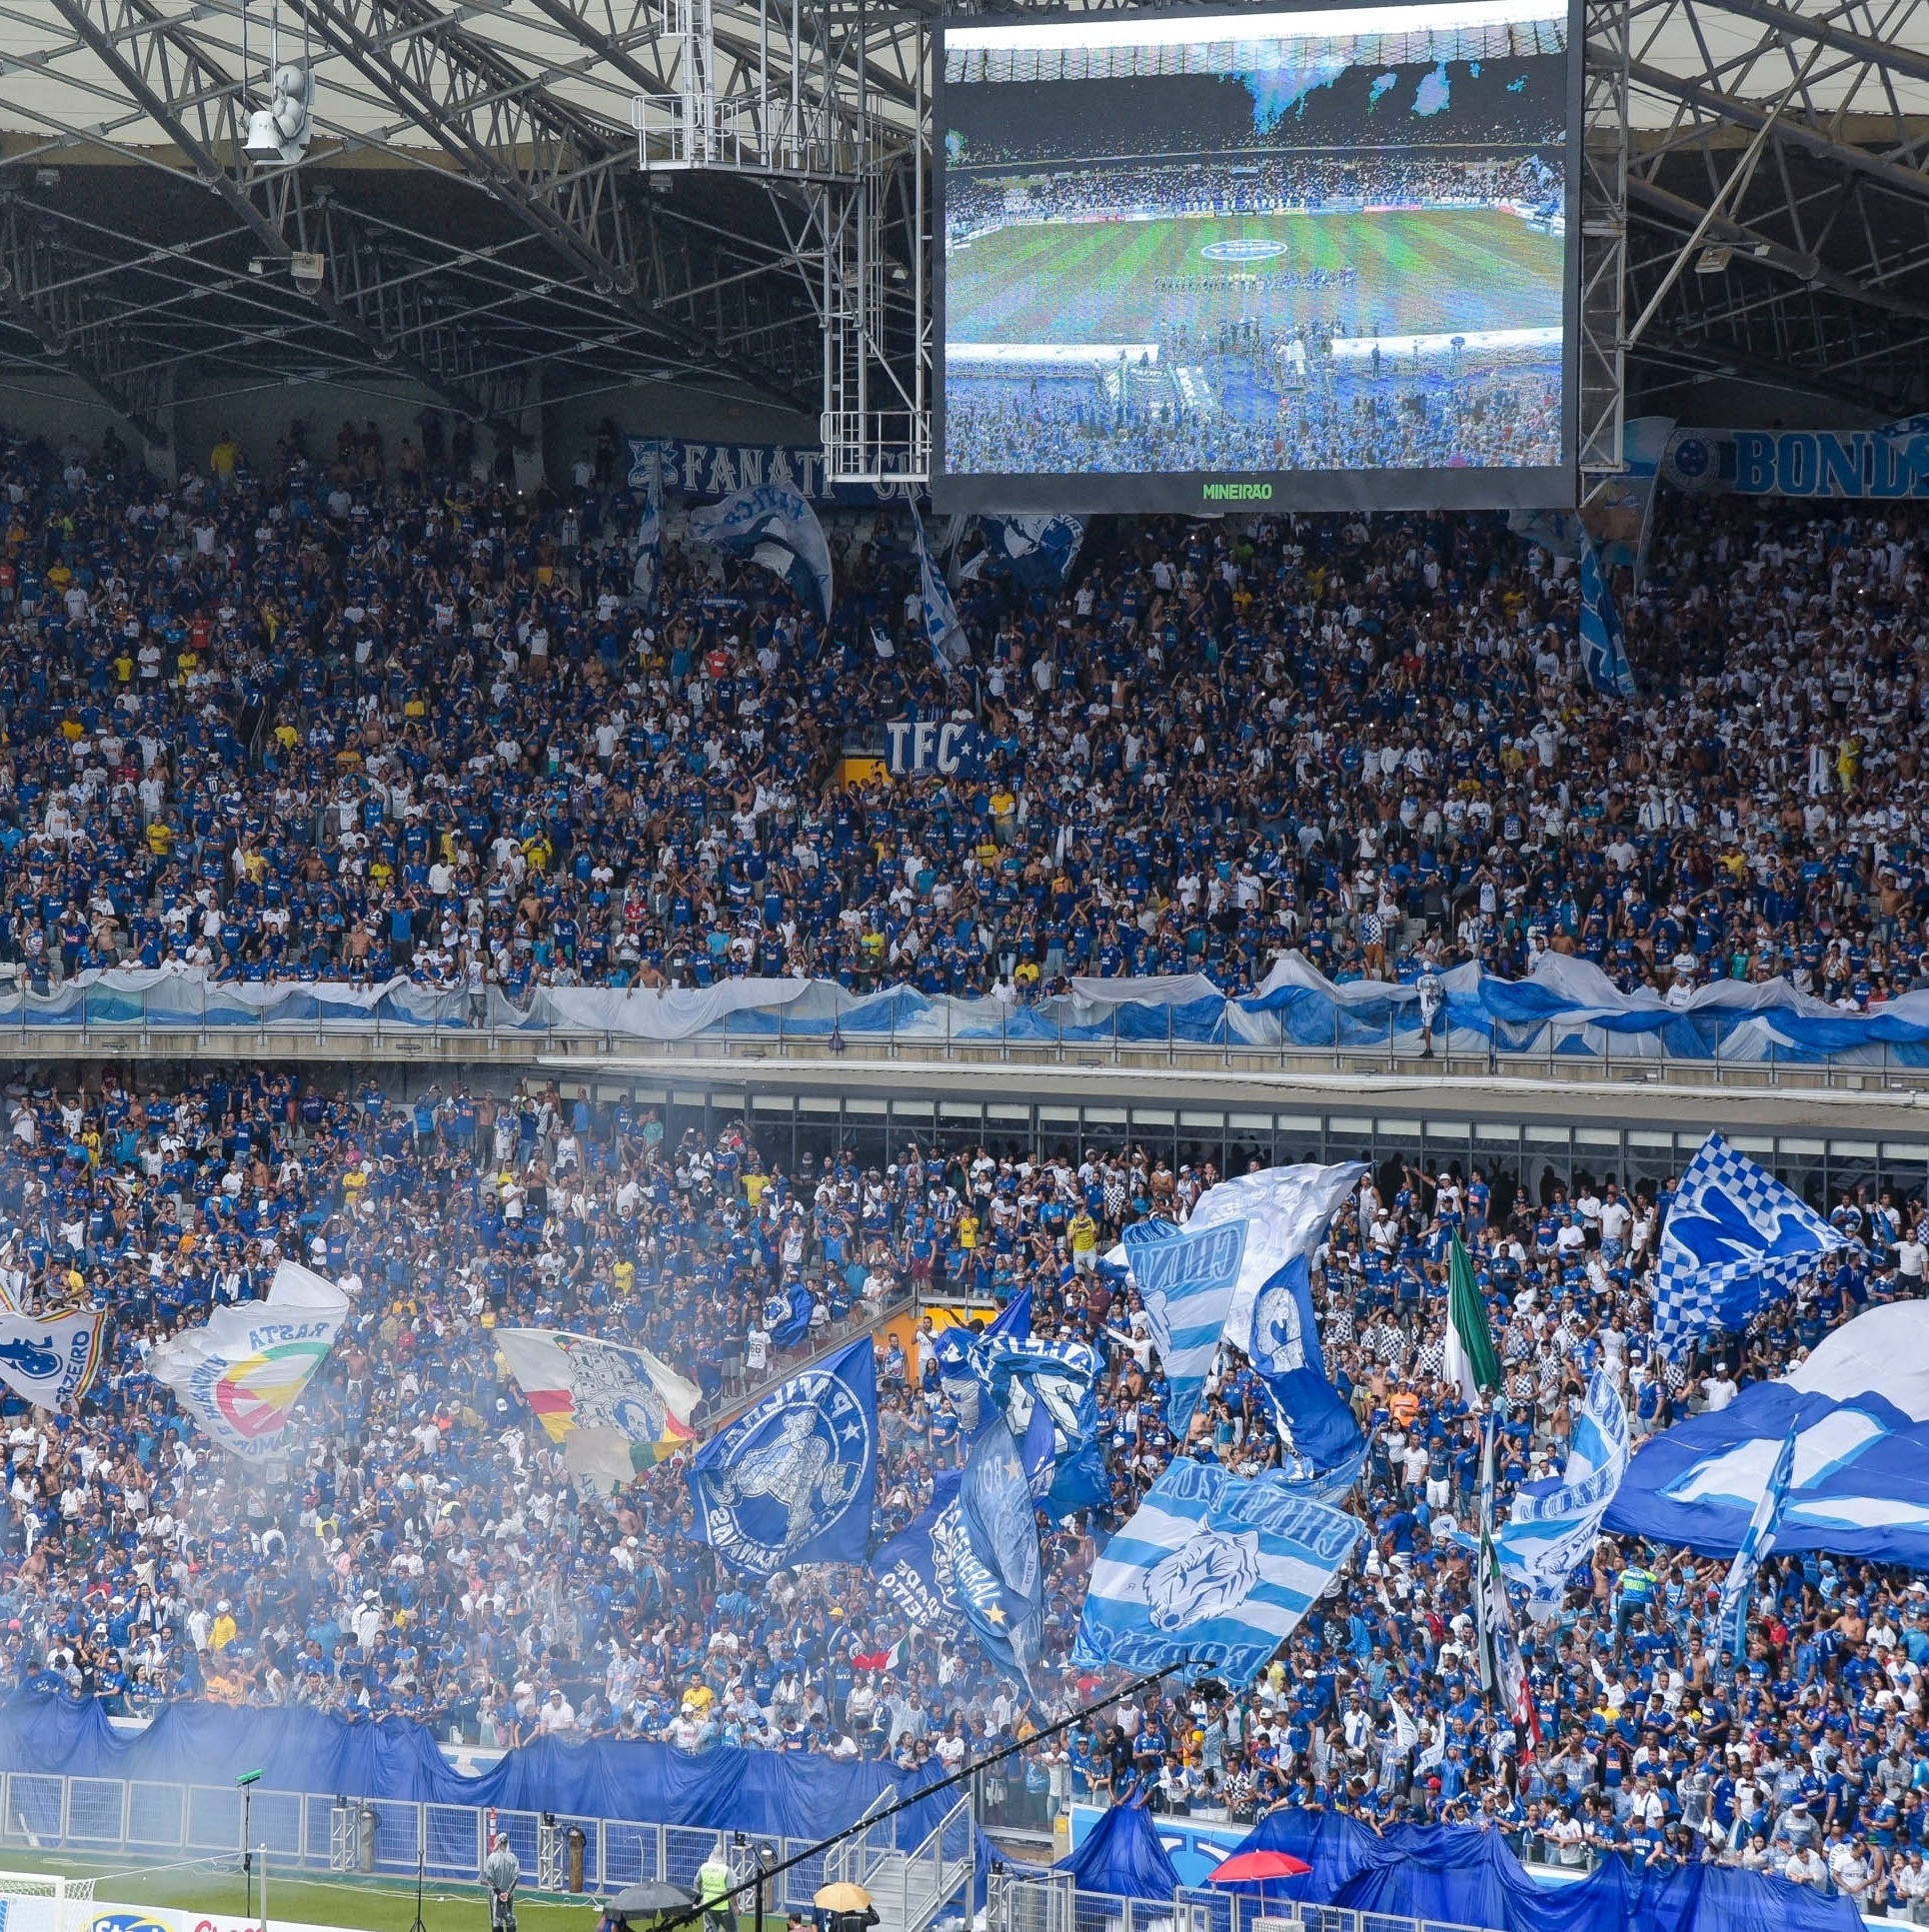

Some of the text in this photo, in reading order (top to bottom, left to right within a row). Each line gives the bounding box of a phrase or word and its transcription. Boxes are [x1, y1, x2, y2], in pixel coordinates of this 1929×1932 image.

[252, 694, 259, 705] 7
[886, 721, 967, 775] TFC
[209, 781, 217, 792] 10
[751, 1342, 761, 1353] 66
[953, 1526, 1003, 1605] GENERAL
